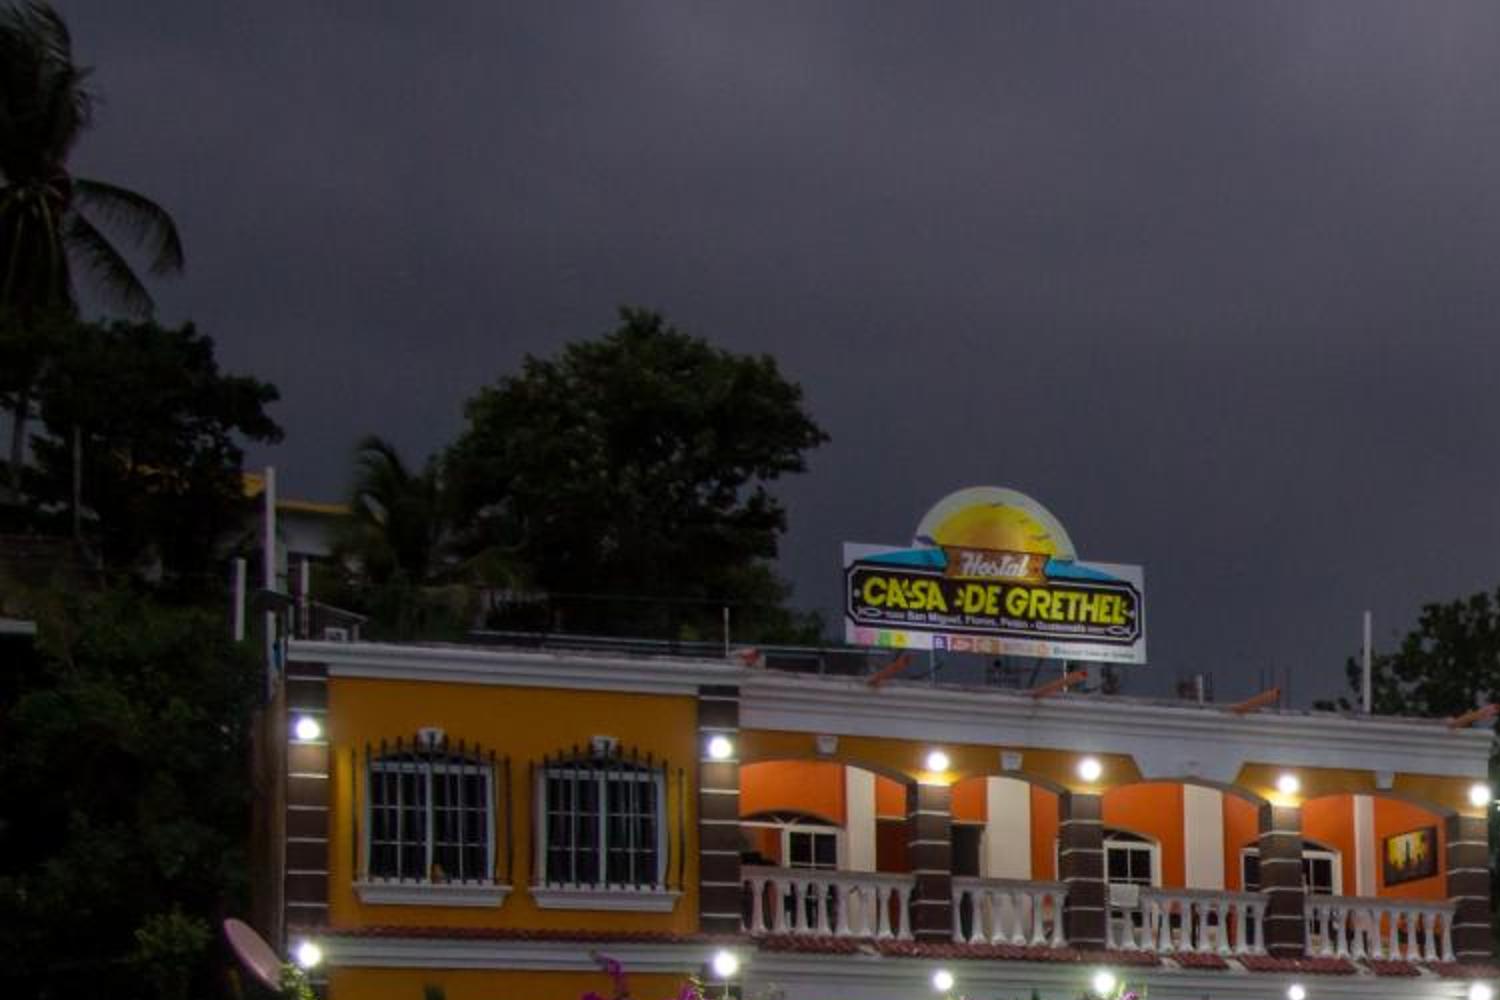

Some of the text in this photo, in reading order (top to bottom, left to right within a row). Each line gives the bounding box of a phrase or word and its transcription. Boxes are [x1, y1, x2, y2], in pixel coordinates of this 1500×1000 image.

[961, 550, 1030, 577] Hostal
[863, 576, 1126, 625] CASA DE GRETHEL
